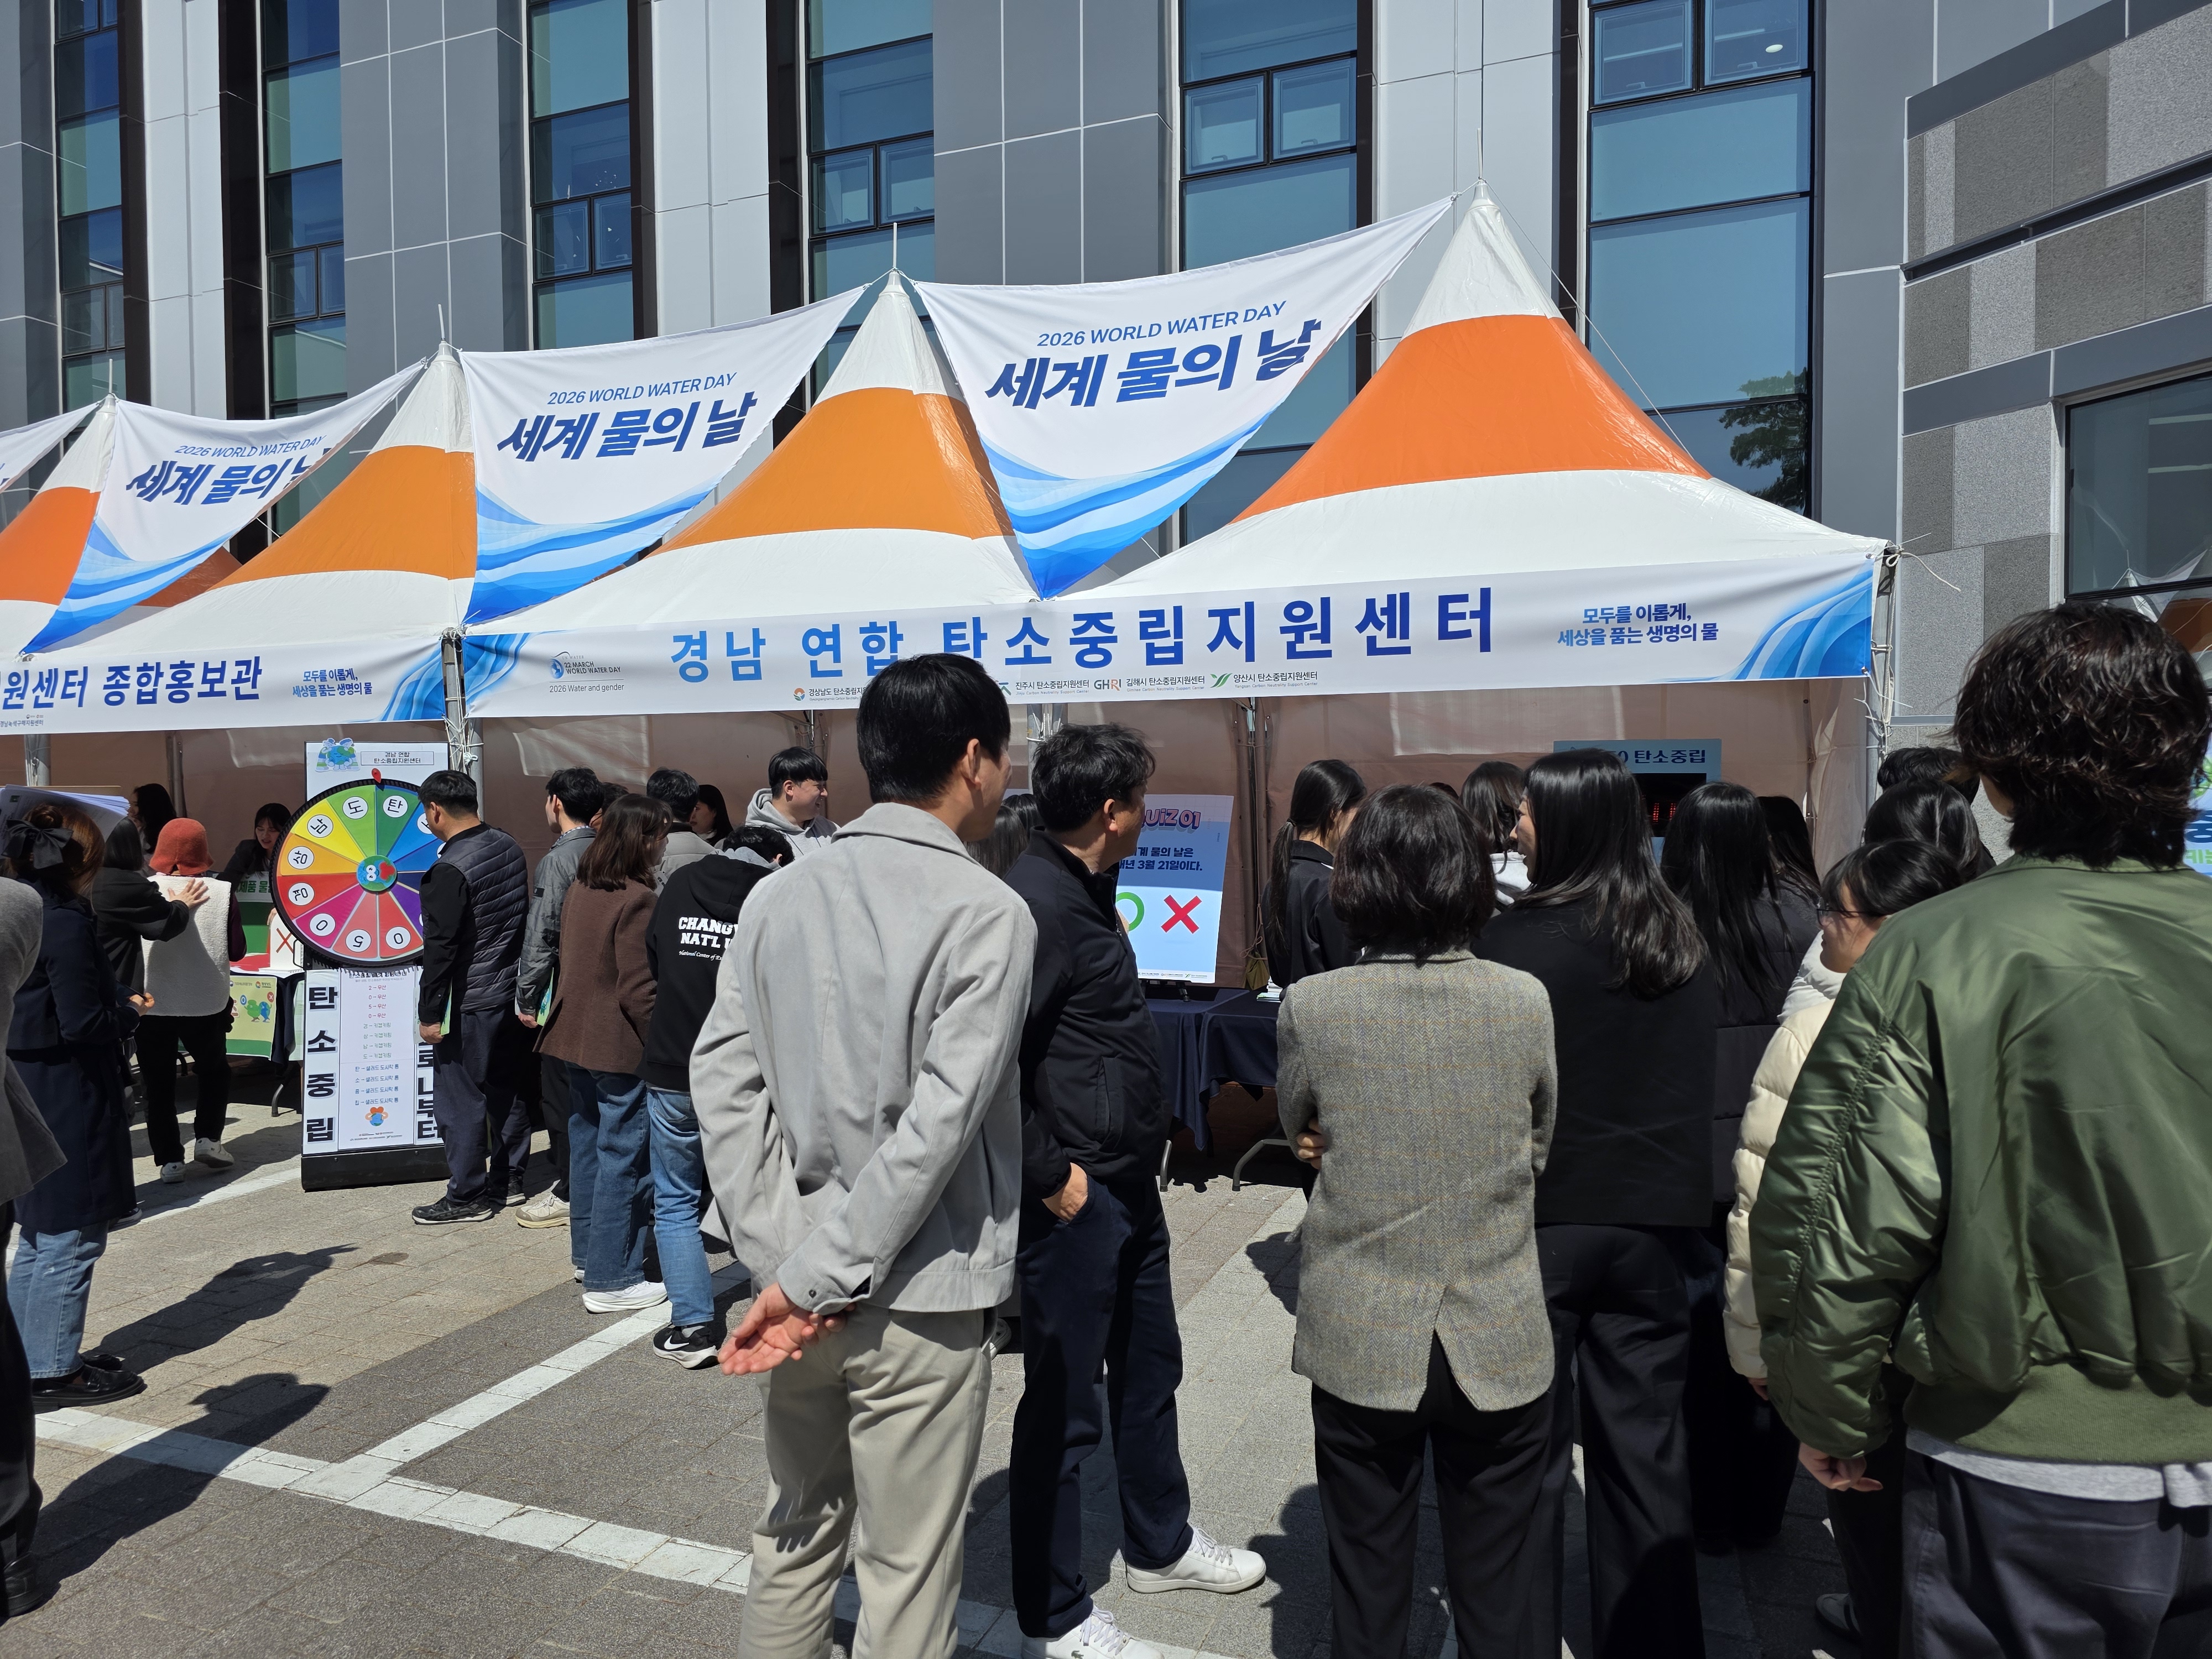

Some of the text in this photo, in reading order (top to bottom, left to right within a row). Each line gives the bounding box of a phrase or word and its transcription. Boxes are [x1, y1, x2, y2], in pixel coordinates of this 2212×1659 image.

[1037, 300, 1286, 347] 2026 WORLD WATER DAY
[985, 319, 1322, 409] 세계 물의 날
[547, 372, 738, 405] 2026 WORLD WATER DAY
[497, 391, 758, 462] 세계 물의 날
[174, 435, 327, 457] 2026 WORLD WATER DAY
[126, 461, 216, 505] 세계
[201, 458, 293, 504] 물의
[1583, 602, 1692, 624] 모두를 이롭게,
[671, 587, 1491, 684] 경남 연합 탄소중립지원센터
[1557, 623, 1719, 646] 세상을 품는 생명의 물
[303, 668, 358, 682] 모두를 이롭게,
[1126, 676, 1205, 686] 김해시 탄소중립지원센터
[1233, 671, 1317, 683] 양산시 탄소중립지원센터
[0, 656, 263, 710] 원센터 종합홍보관
[293, 682, 373, 697] 세상을 품는 생명의 물
[602, 684, 624, 692] gender
[1016, 680, 1089, 690] 진주시 탄소중립지원센터
[1094, 679, 1121, 691] GHRI
[809, 688, 832, 696] 경상남도
[1634, 749, 1705, 764] 탄소중립
[347, 800, 363, 814] 도
[388, 799, 403, 813] 탄
[311, 819, 327, 834] 남
[1179, 810, 1201, 830] 01
[294, 850, 308, 865] 상
[1151, 847, 1171, 857] 물의
[1173, 848, 1193, 857] 날은
[1138, 860, 1155, 869] 3월
[1157, 860, 1203, 870] 21일이다.
[293, 888, 309, 901] 경
[353, 935, 364, 948] 5
